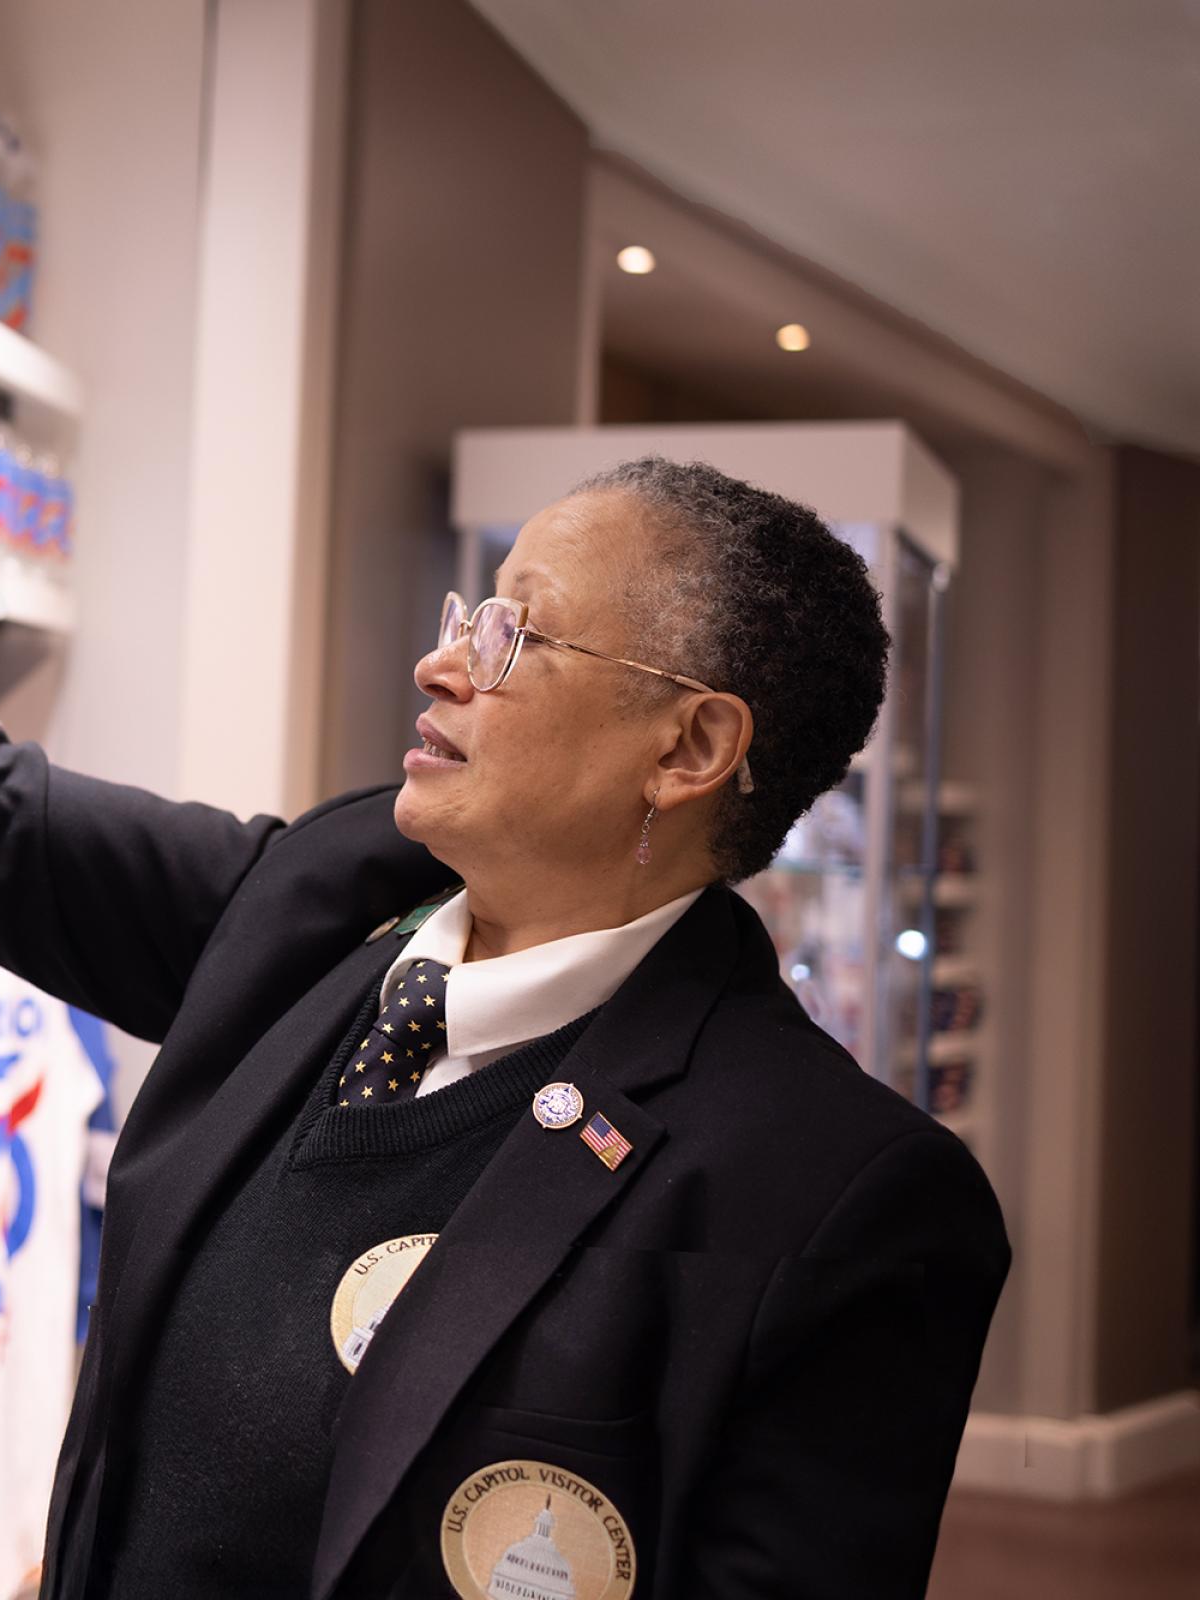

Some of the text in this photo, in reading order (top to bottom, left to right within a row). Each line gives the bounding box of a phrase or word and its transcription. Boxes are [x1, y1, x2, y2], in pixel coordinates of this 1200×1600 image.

[354, 1236, 438, 1276] U.S. CAPIT
[448, 1466, 631, 1581] U.S. CAPITOL VISITOR CENTER
